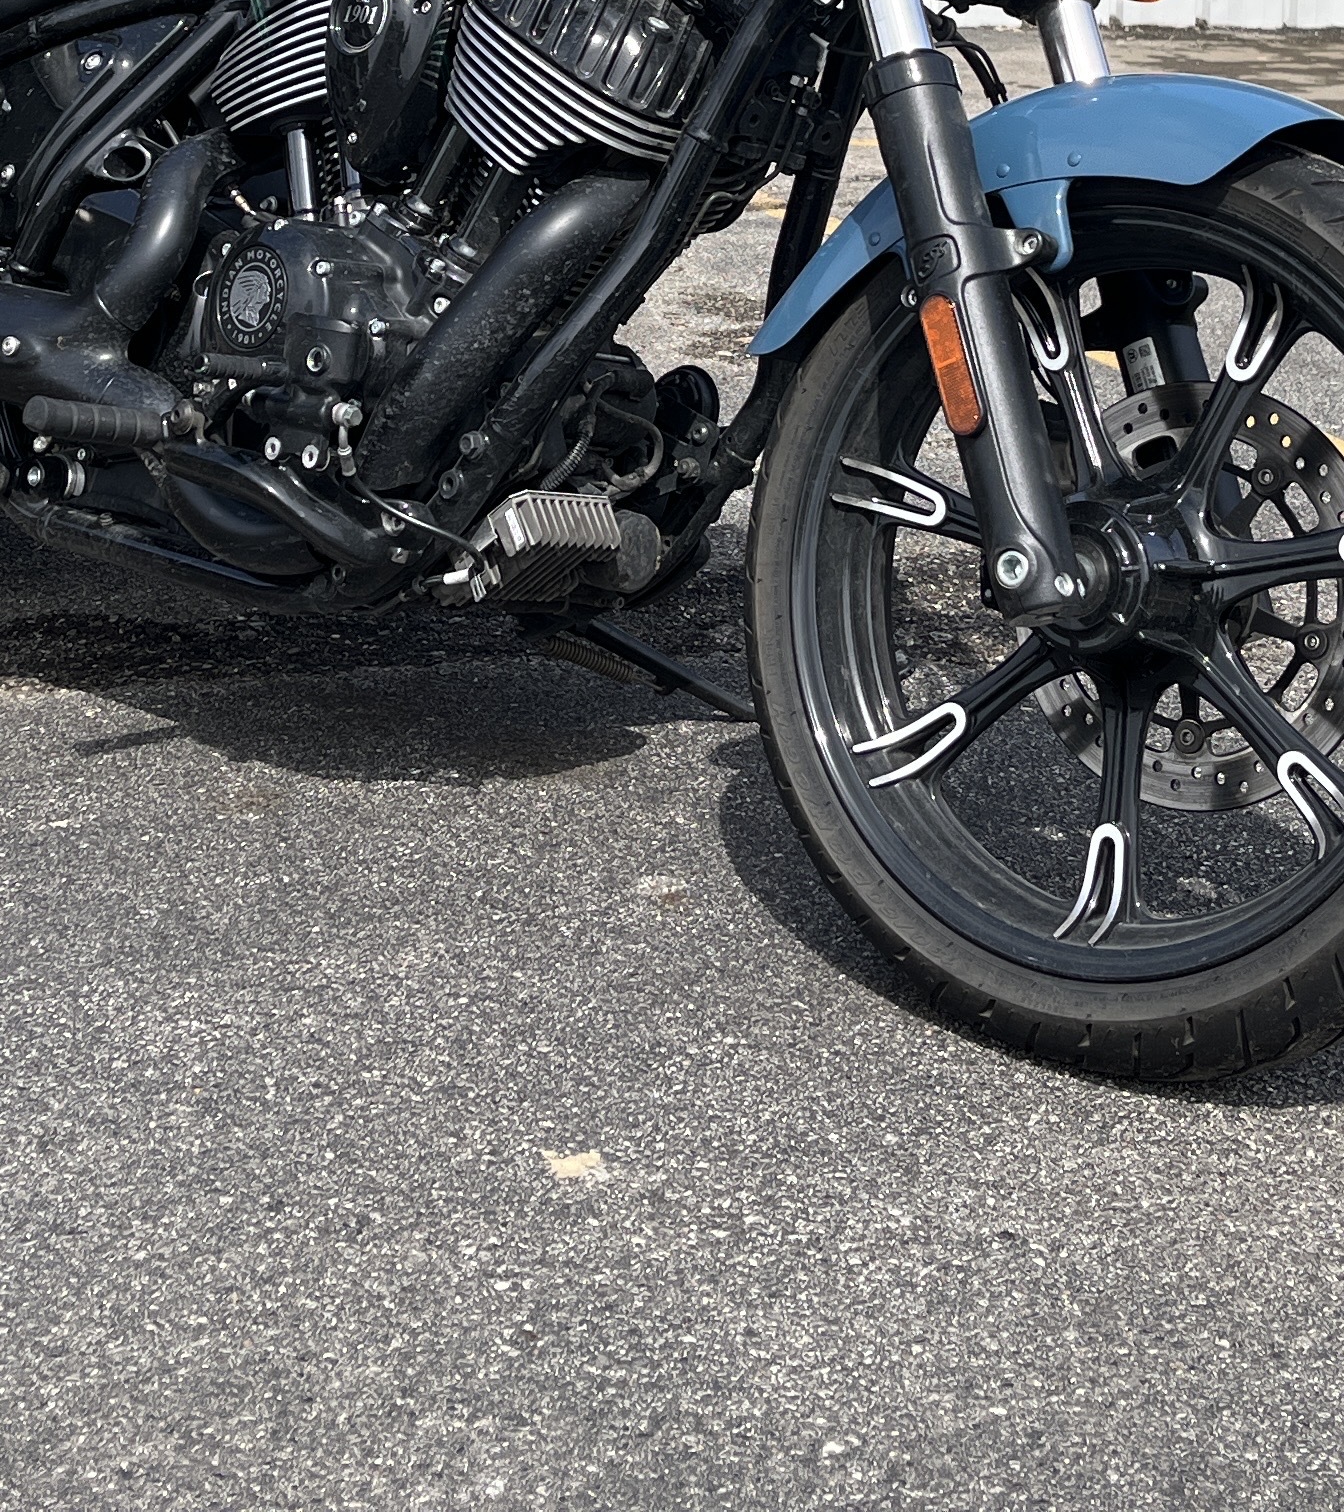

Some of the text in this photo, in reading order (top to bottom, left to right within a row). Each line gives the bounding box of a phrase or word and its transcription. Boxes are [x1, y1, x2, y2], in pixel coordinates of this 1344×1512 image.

[344, 5, 378, 25] 1901
[221, 249, 284, 345] INDIAN MOTORCYCLE 1901
